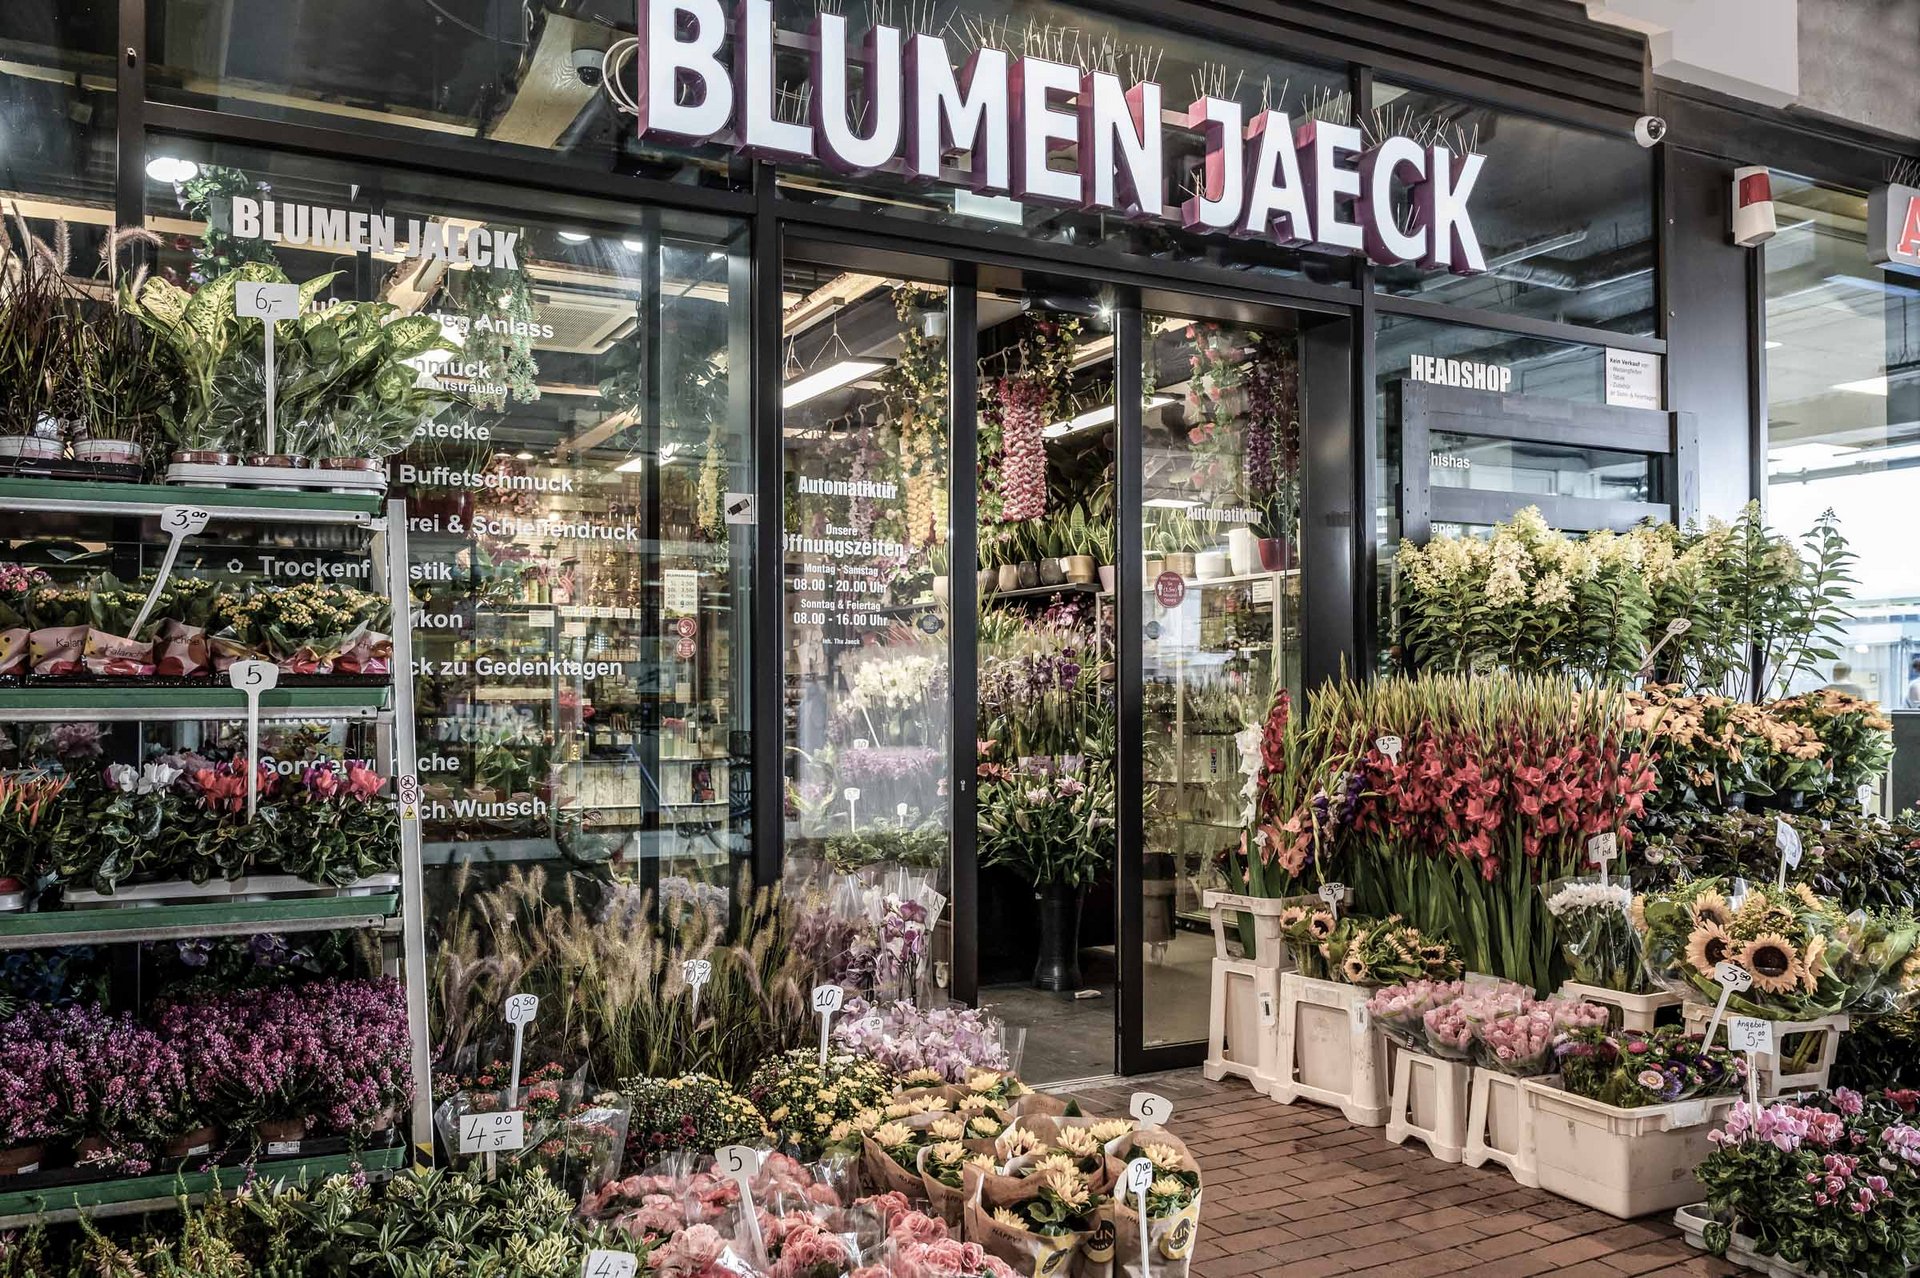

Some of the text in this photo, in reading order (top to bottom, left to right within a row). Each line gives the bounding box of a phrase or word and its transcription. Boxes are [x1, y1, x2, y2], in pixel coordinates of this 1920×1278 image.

[640, 0, 1487, 272] BLUMEN JAECK
[231, 195, 518, 271] BLUMEN JAECK
[476, 314, 554, 339] Anlass
[1410, 354, 1512, 393] HEADSHOP
[415, 420, 490, 442] stecke
[1429, 452, 1471, 469] hishas
[400, 464, 573, 492] Buffetschmuck
[798, 476, 899, 499] Automatiktür
[447, 516, 464, 534] &
[472, 516, 638, 541] Schleifendruck
[826, 523, 858, 537] Unsere
[804, 563, 836, 576] Montag
[843, 565, 879, 577] Samstag
[793, 578, 826, 592] 08.00
[836, 580, 867, 593] 20.00
[870, 581, 888, 594] Uhr
[801, 599, 881, 613] Sonntag & Feiertag
[413, 609, 463, 629] kon
[793, 612, 826, 625] 08.00
[836, 613, 867, 626] 16.00
[870, 614, 888, 627] Uhr
[245, 664, 262, 685] 5
[440, 660, 467, 675] zu
[475, 657, 623, 679] Gedenktagen
[452, 797, 547, 818] Wunsch
[1737, 1020, 1767, 1031] Angebot
[1141, 1098, 1155, 1116] 6
[729, 1148, 743, 1172] 5
[1093, 1229, 1115, 1241] UN
